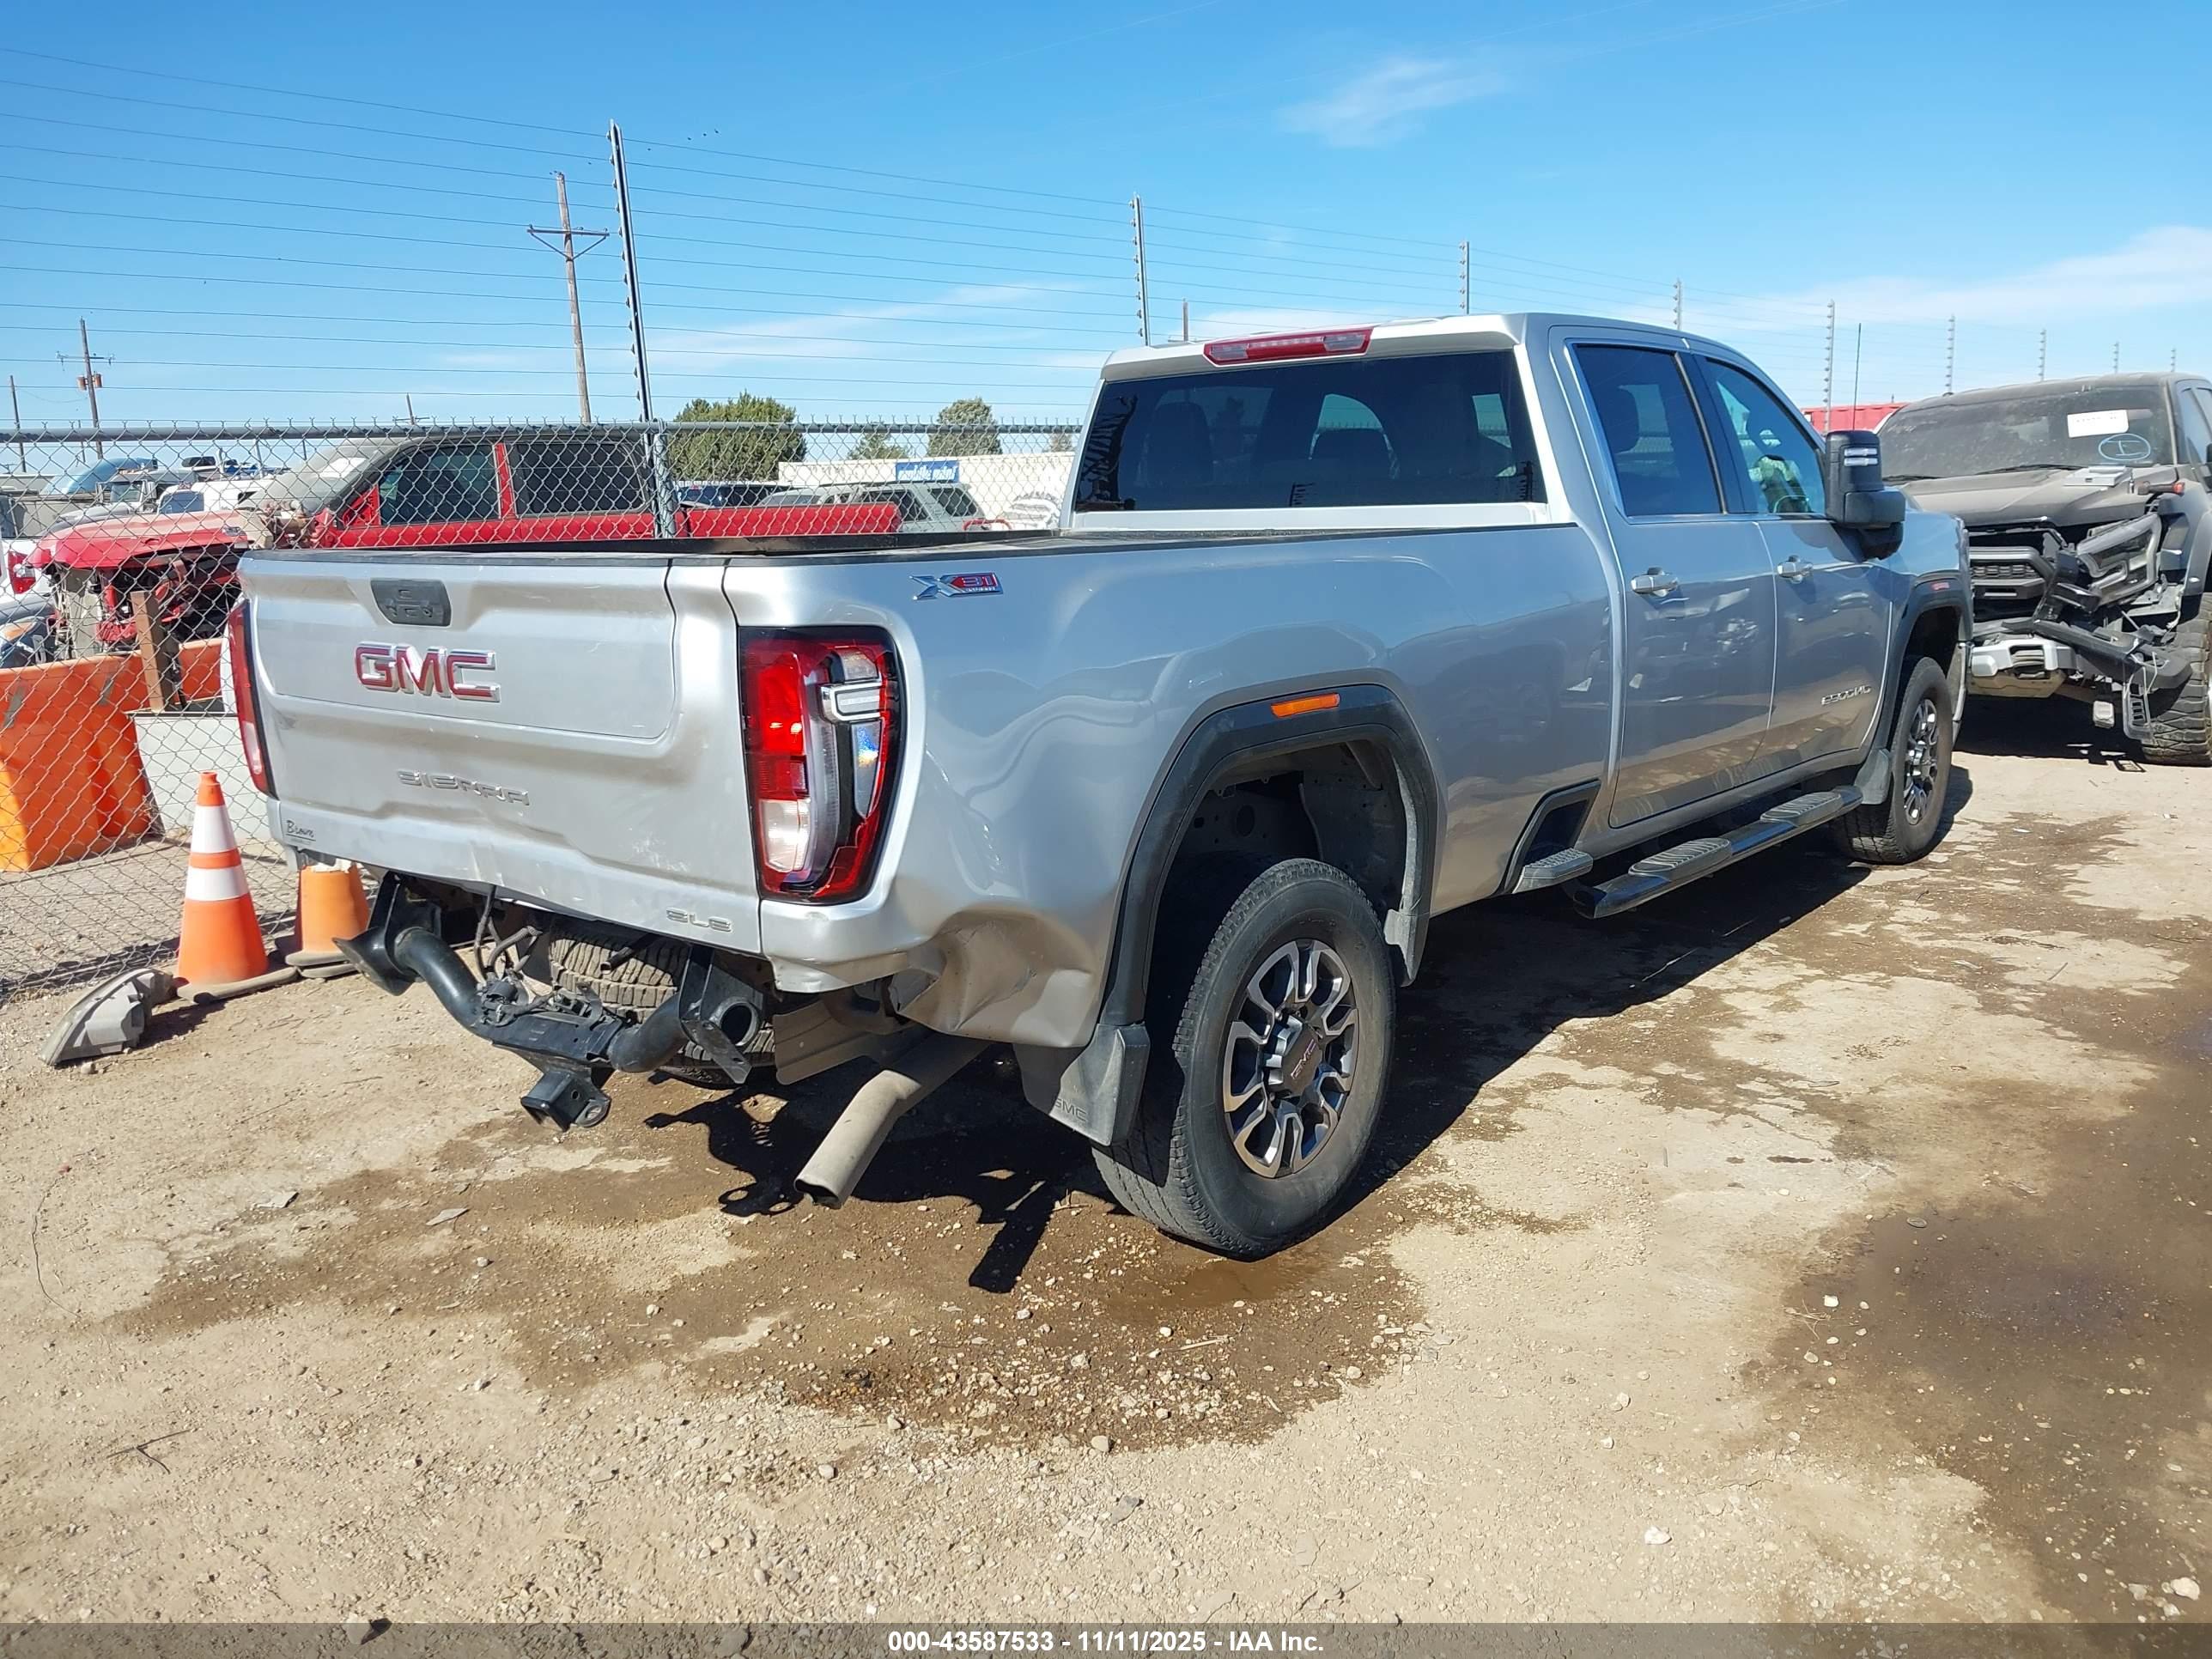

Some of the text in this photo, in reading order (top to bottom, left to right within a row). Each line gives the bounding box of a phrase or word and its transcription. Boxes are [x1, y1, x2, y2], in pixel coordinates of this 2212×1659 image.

[355, 641, 501, 703] GMC
[398, 769, 530, 806] SIERRA
[666, 908, 732, 933] SLE
[1291, 1038, 1317, 1080] GMC
